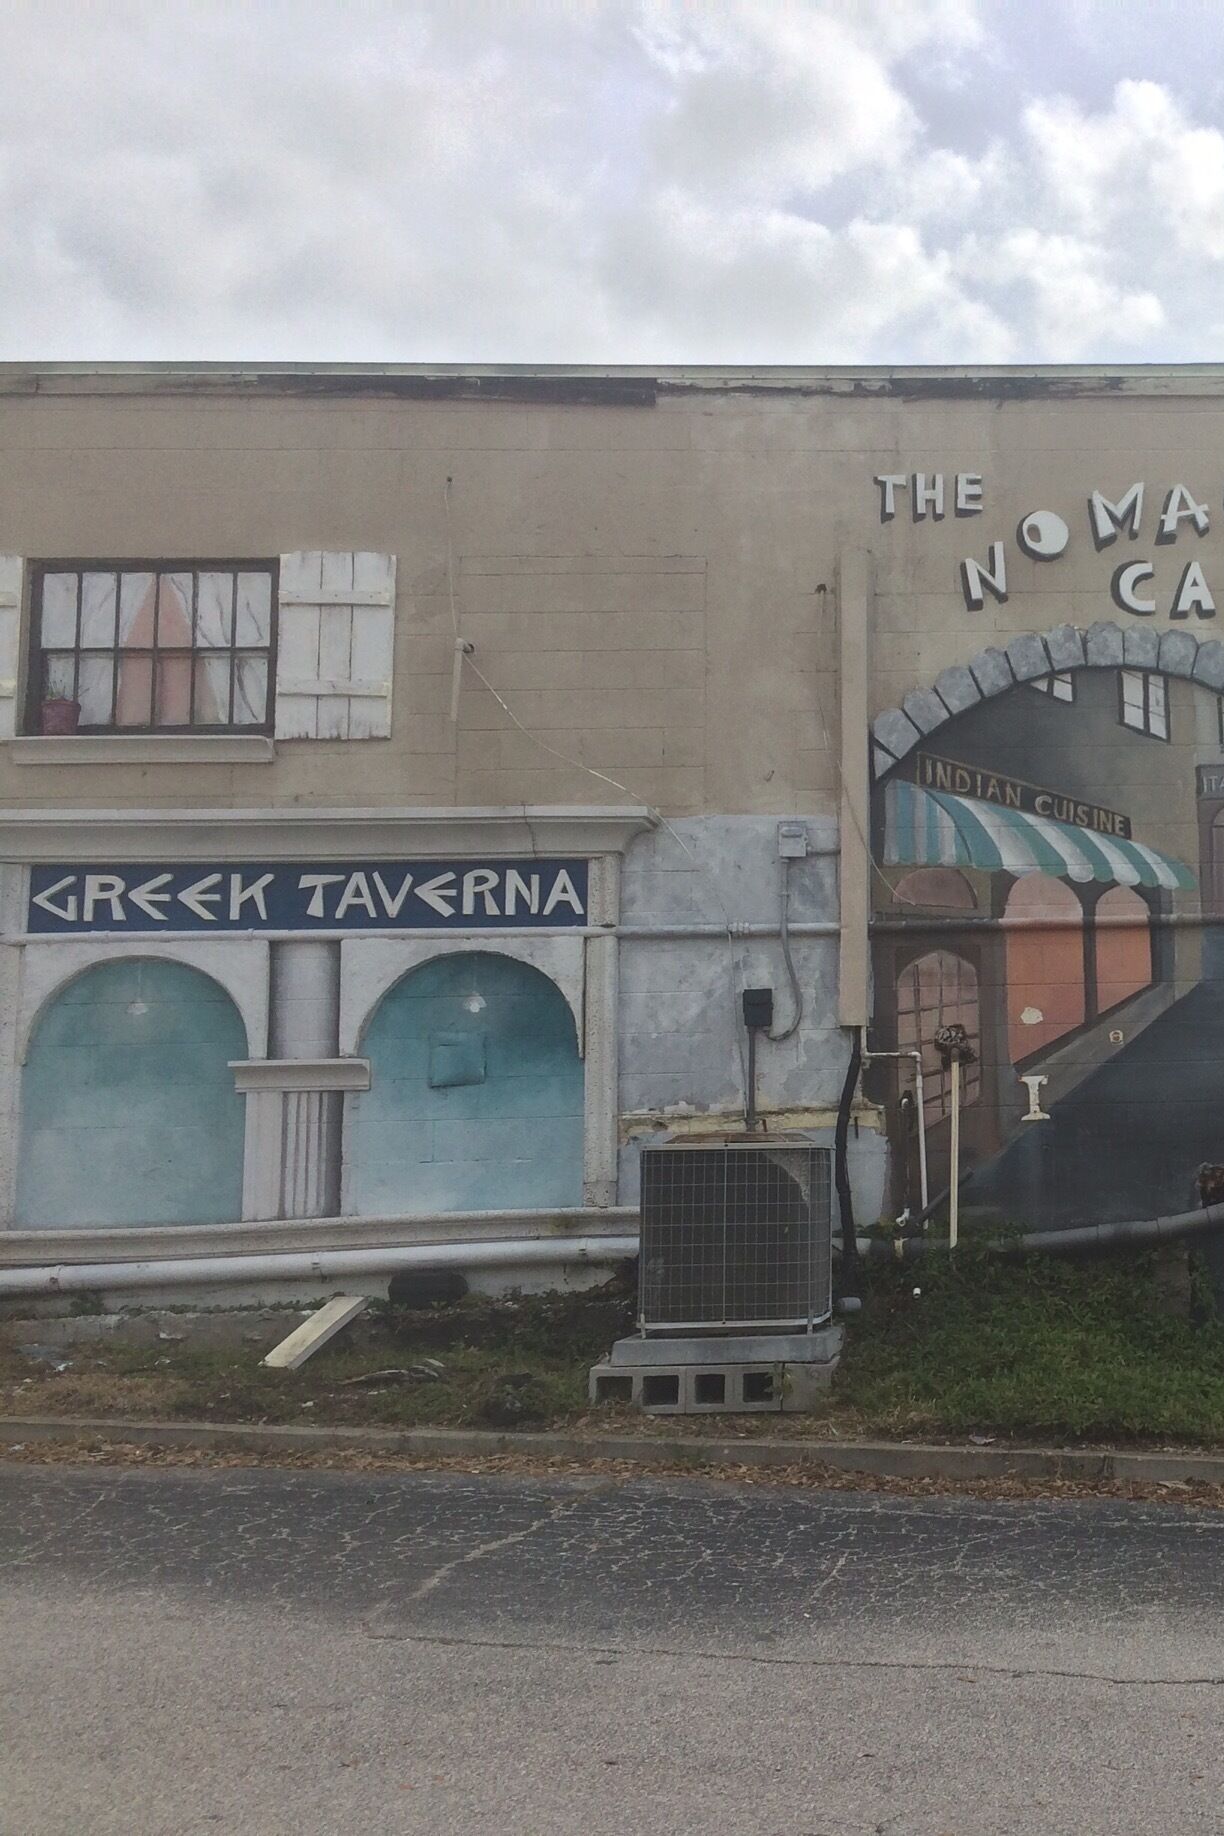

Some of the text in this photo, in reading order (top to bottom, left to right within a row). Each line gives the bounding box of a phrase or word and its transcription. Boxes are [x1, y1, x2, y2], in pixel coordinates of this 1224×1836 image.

[874, 472, 984, 523] THE
[926, 758, 1125, 837] INDIAN CUISINE
[32, 868, 585, 922] GREEK TAVERNA
